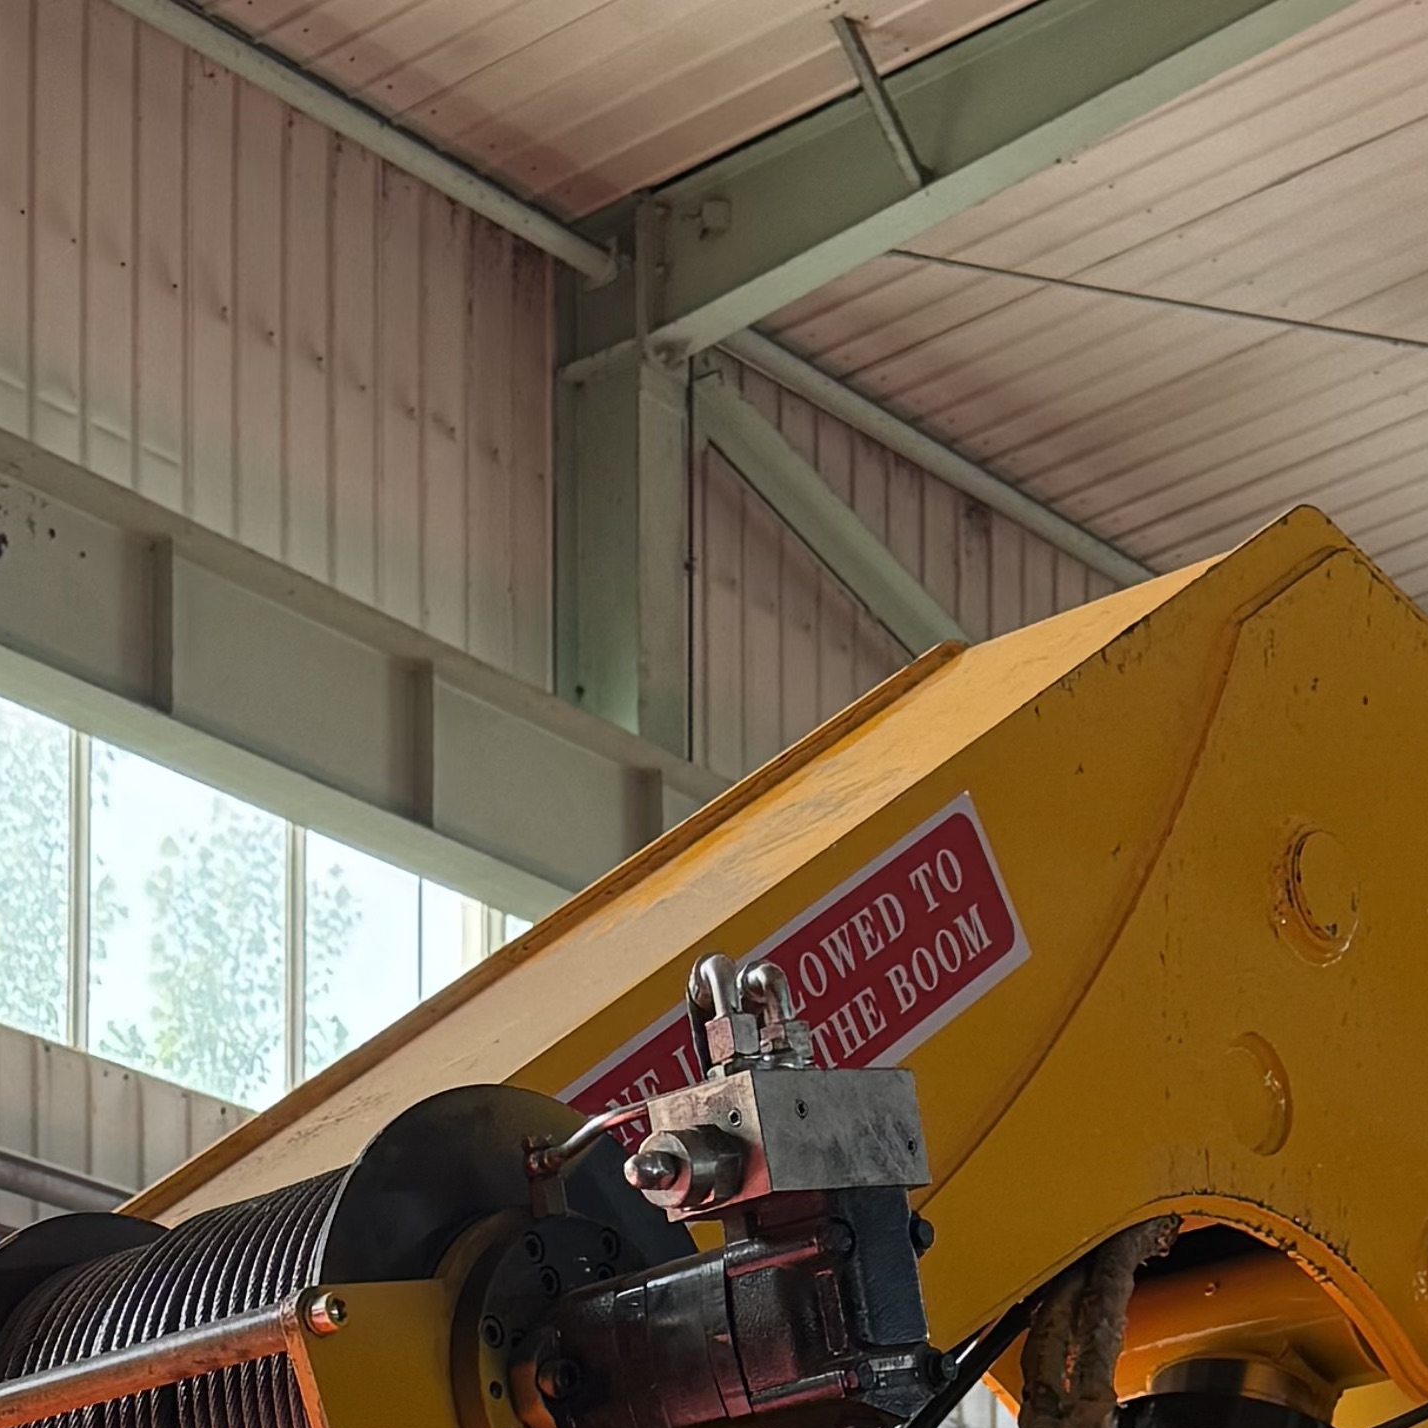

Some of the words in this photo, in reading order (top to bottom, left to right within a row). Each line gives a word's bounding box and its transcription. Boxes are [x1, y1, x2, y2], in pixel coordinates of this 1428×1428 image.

[908, 849, 963, 913] TO
[809, 986, 888, 1069] THE
[884, 903, 993, 1015] BOOM
